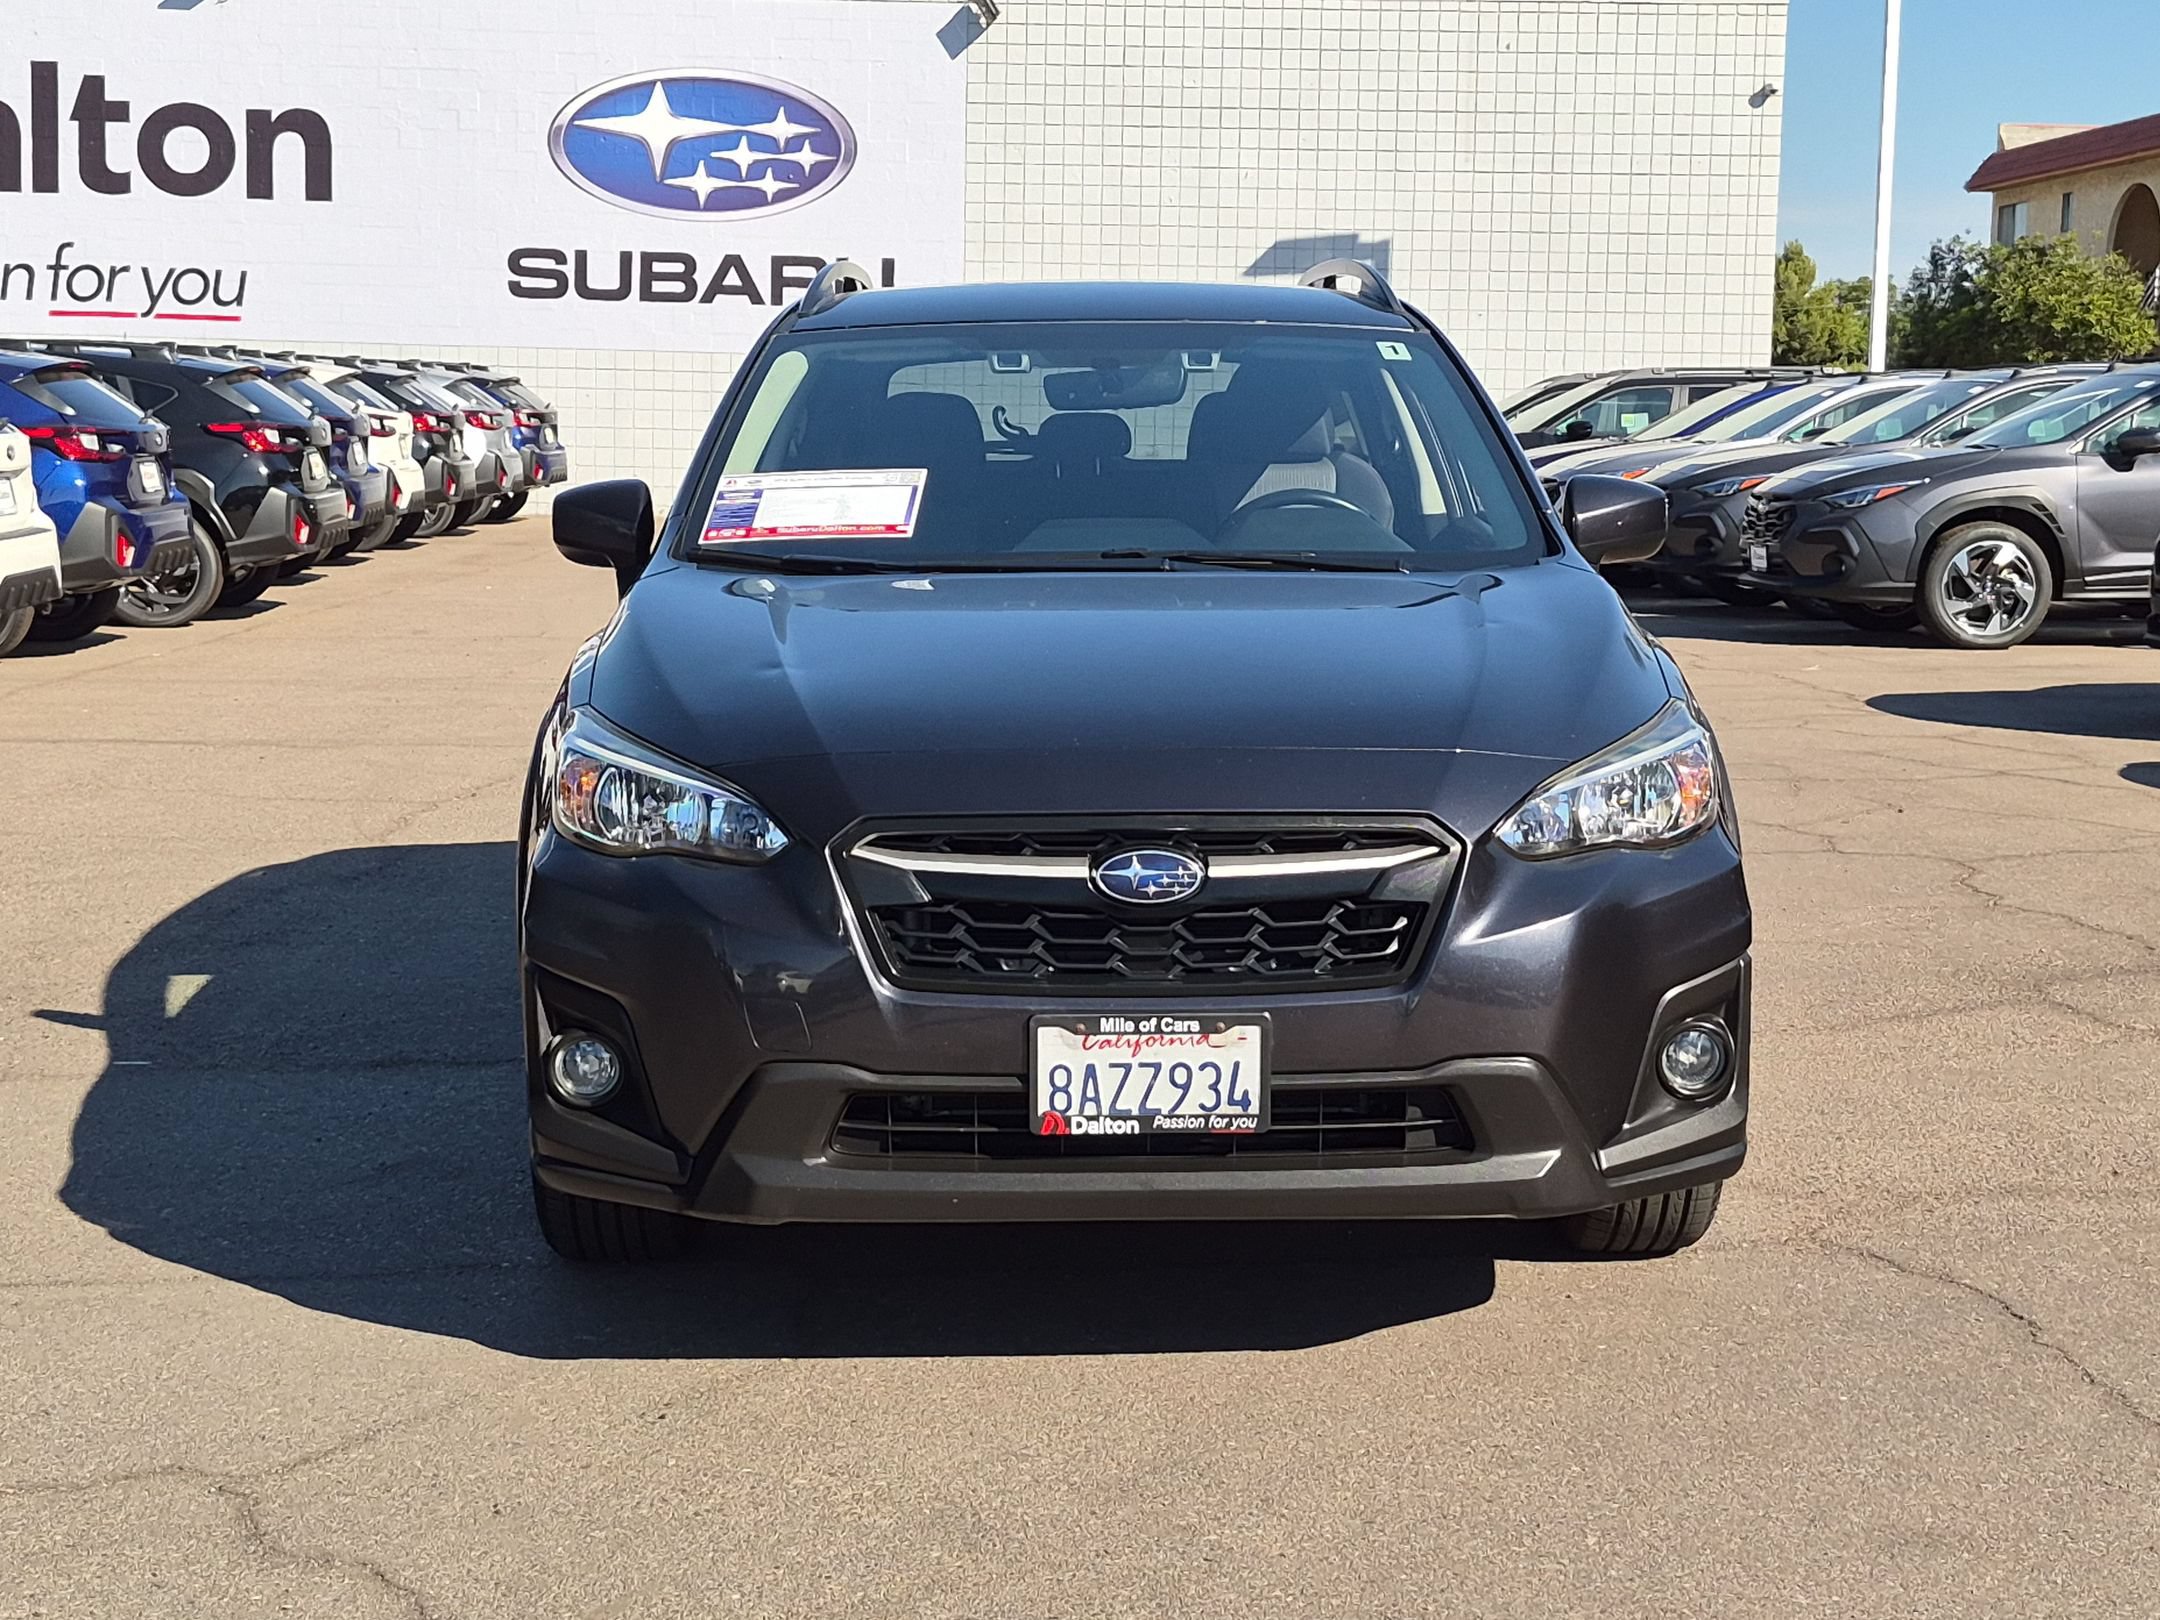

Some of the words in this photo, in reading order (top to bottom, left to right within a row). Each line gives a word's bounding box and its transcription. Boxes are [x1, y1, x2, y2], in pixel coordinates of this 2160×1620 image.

[0, 60, 333, 202] lton
[46, 241, 131, 302] for
[141, 264, 248, 318] you
[1100, 1017, 1134, 1032] Mile
[1138, 1017, 1157, 1032] of
[1160, 1016, 1200, 1032] Cars
[1082, 1034, 1226, 1057] California
[1049, 1061, 1252, 1115] 8AZZ934
[1071, 1116, 1140, 1135] Dalton
[1153, 1115, 1206, 1129] Passion
[1208, 1115, 1231, 1129] for
[1230, 1117, 1258, 1131] you
